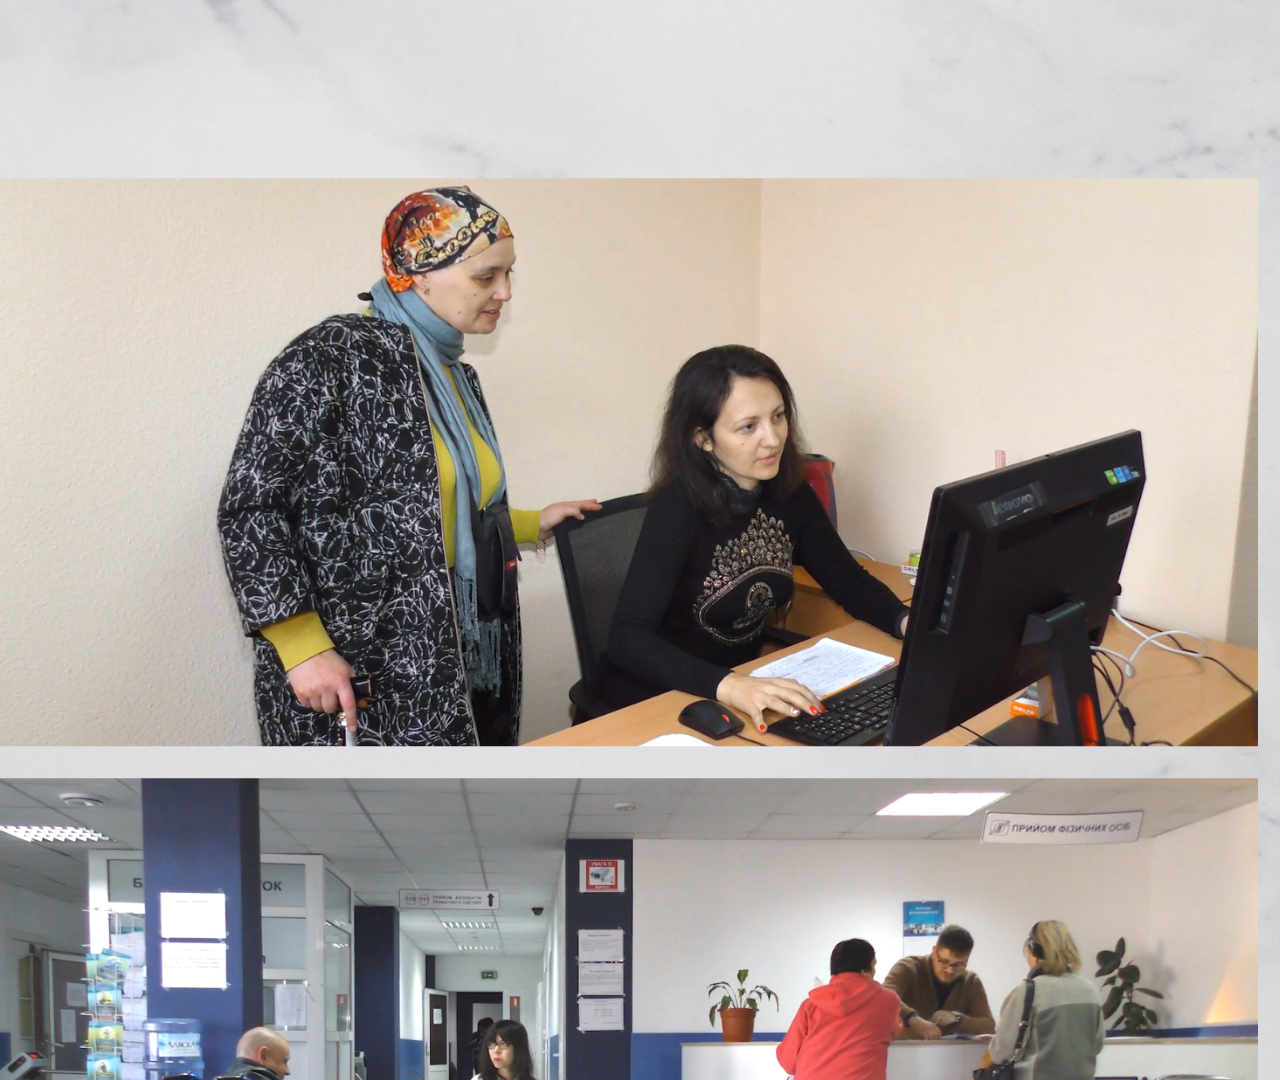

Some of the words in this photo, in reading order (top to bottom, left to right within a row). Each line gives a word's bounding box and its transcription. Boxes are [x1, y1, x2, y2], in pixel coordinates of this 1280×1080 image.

[991, 493, 1034, 515] lenovo
[1013, 705, 1035, 715] DELTA
[1011, 823, 1056, 833] ПРИЙОМ
[1058, 823, 1107, 833] ФІЗИЧНИХ
[1108, 822, 1131, 832] ОСІБ
